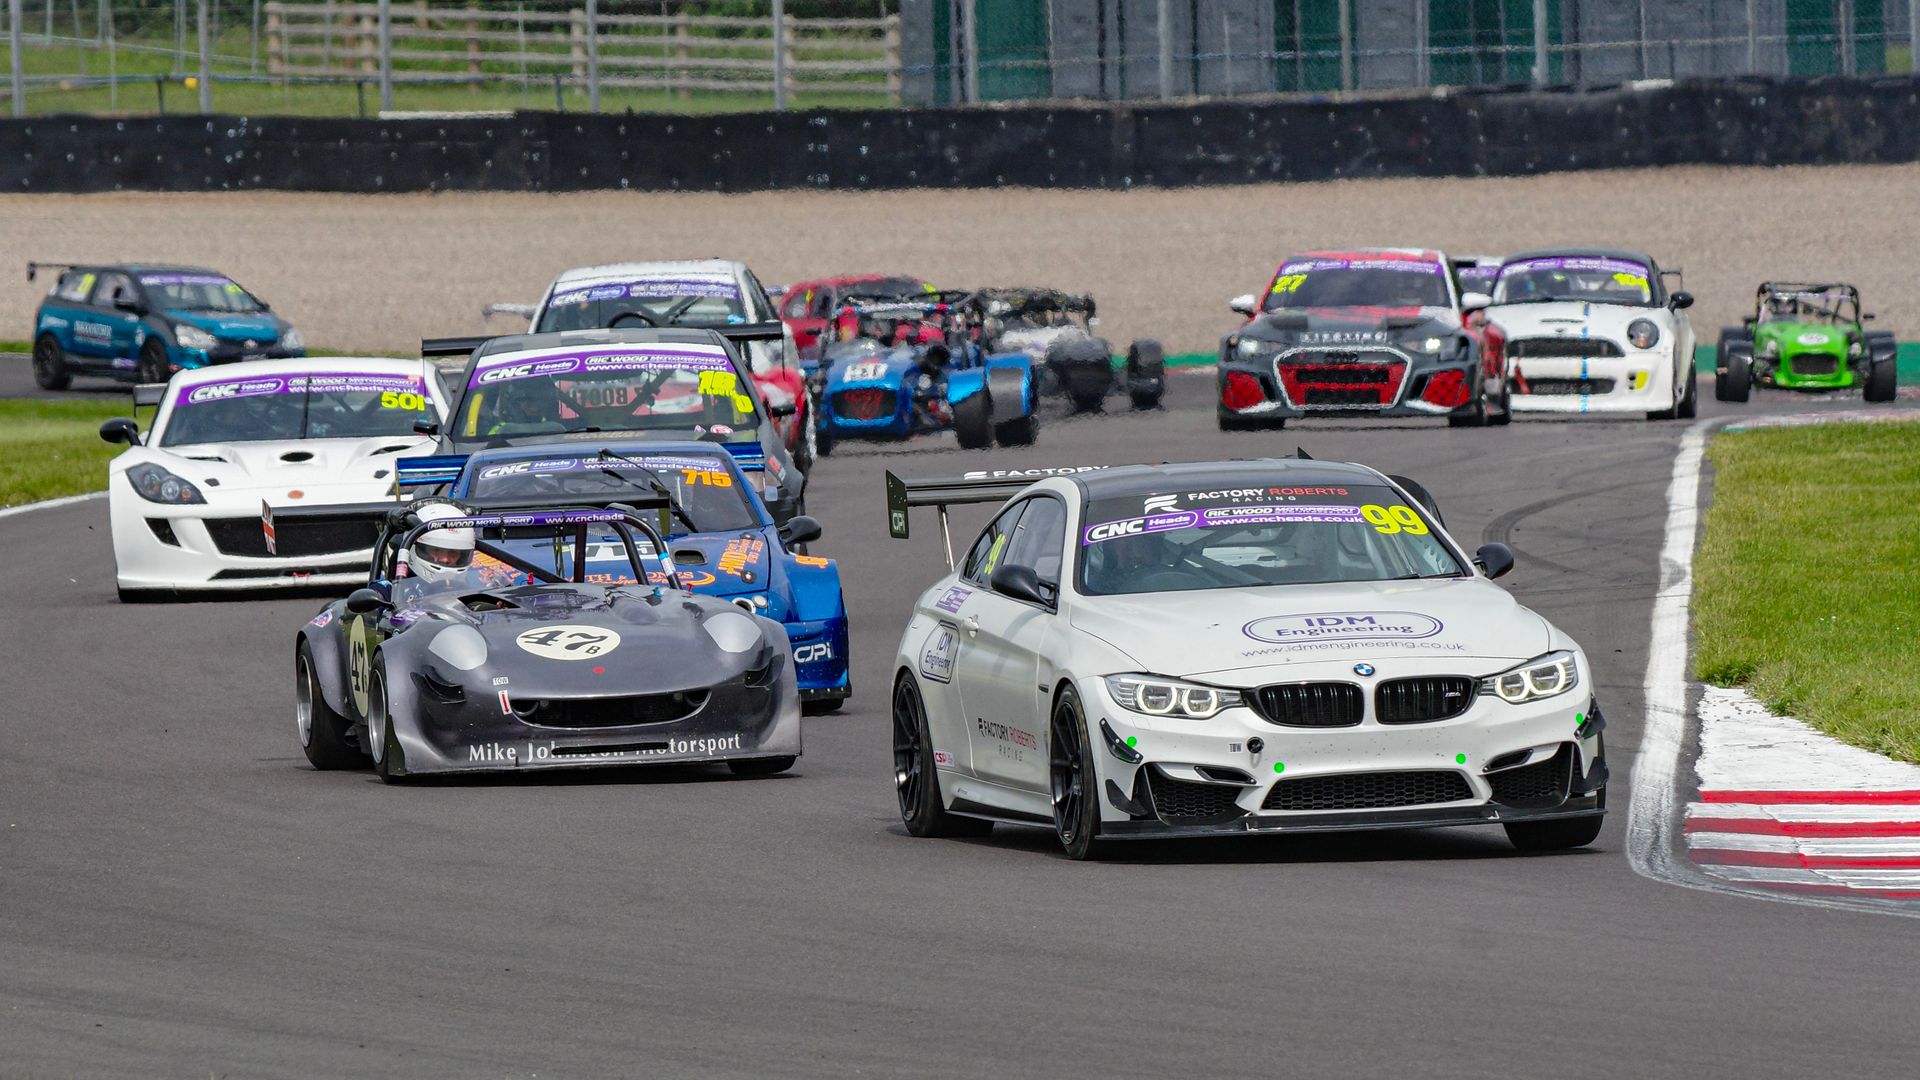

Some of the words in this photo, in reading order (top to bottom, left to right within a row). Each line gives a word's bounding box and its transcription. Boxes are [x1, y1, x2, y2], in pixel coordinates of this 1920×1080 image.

[1271, 274, 1307, 293] 27
[587, 362, 728, 372] www.cncheads.co.uk
[590, 356, 609, 364] RIC
[611, 355, 648, 363] WOOD
[482, 364, 532, 381] CNC
[536, 361, 572, 371] Heads
[193, 384, 239, 400] CNC
[484, 462, 531, 478] CNC
[534, 459, 571, 468] Heads
[585, 463, 719, 473] www.cncheads.co.uk
[681, 469, 732, 488] 715
[1188, 488, 1264, 501] FACTORY
[1269, 487, 1348, 496] ROBERTS
[1233, 495, 1296, 503] RACING
[1208, 509, 1232, 517] RIC
[1233, 507, 1273, 516] WOOD
[1361, 504, 1429, 535] 99
[431, 521, 445, 531] RIC
[446, 520, 474, 529] WOOD
[1091, 519, 1145, 540] CNC
[1149, 515, 1190, 526] Heads
[1207, 515, 1364, 526] www.cncheads.co.uk
[1304, 614, 1376, 627] IDM
[1276, 624, 1414, 637] Engineering
[1242, 640, 1465, 657] www.idmengineering.co.uk
[983, 720, 1009, 741] FACTORY
[1009, 726, 1038, 751] ROBERTS
[469, 743, 516, 762] Mike
